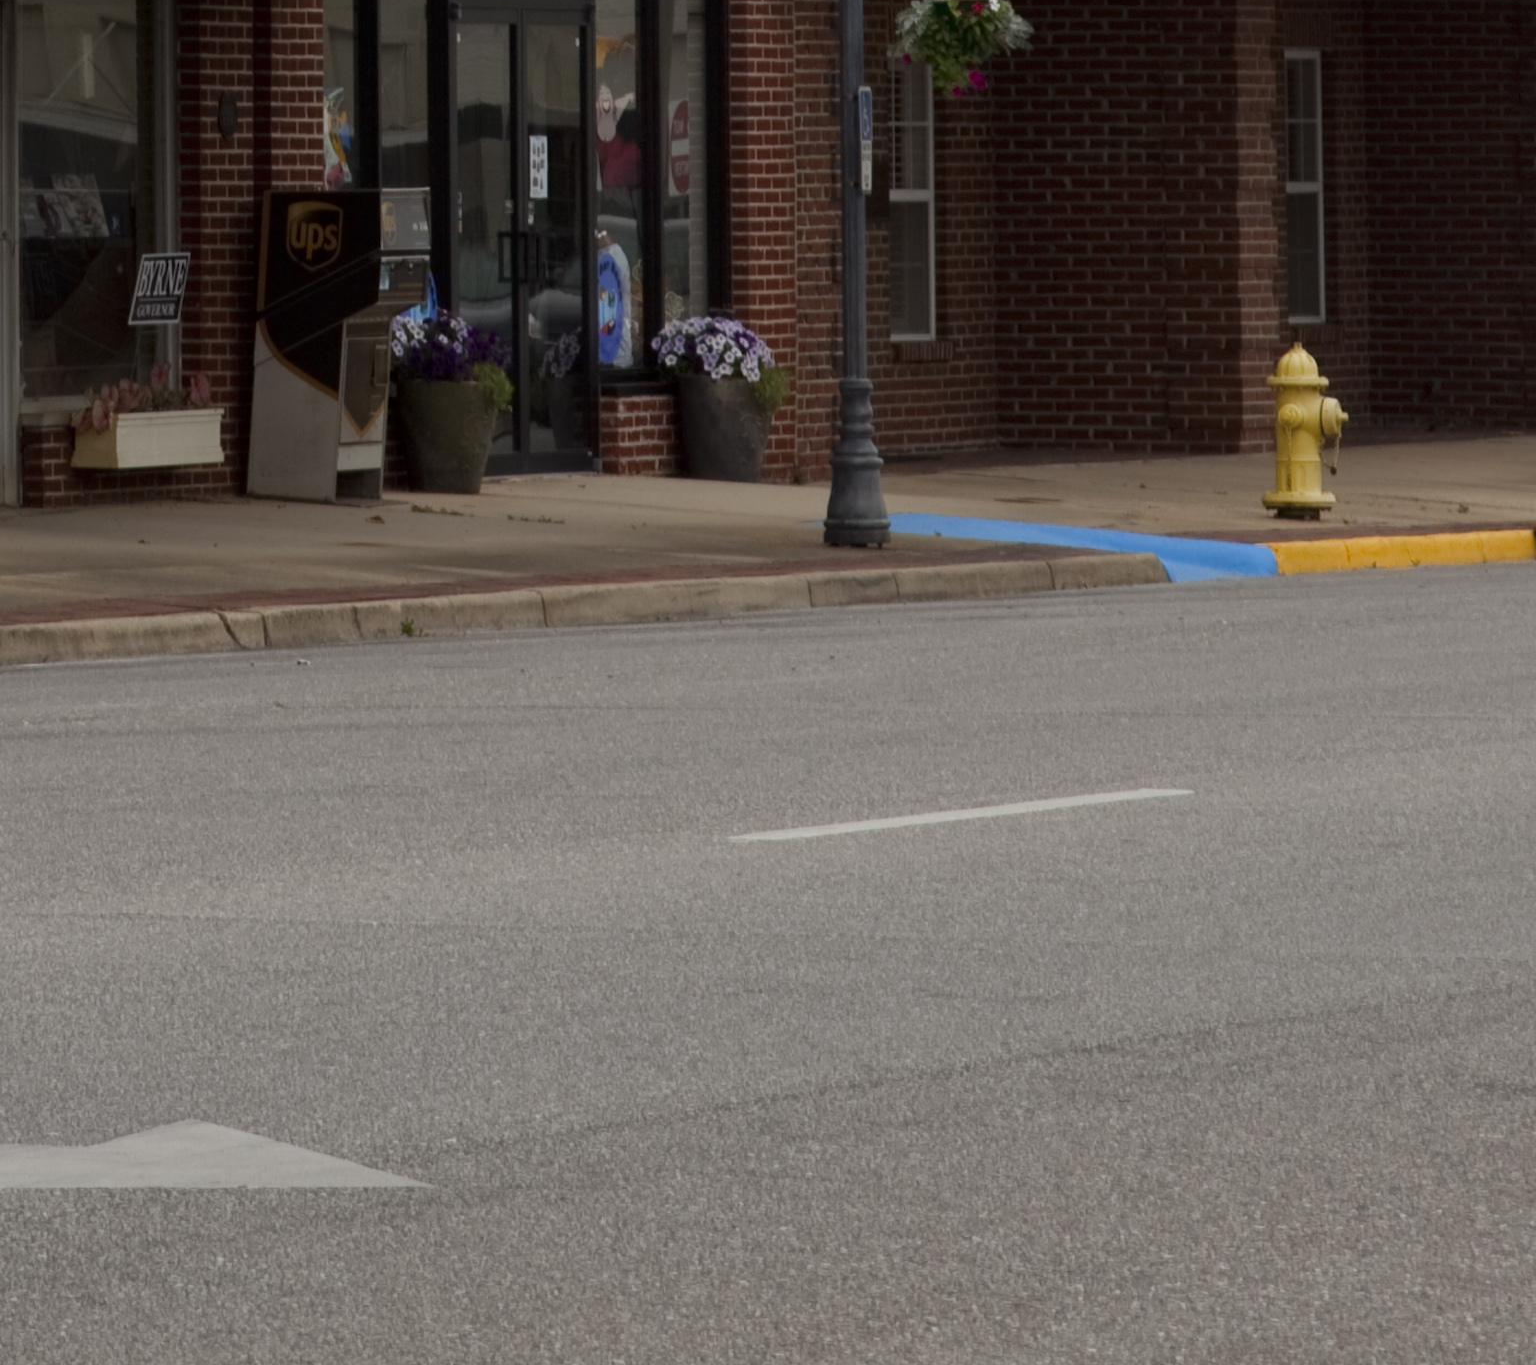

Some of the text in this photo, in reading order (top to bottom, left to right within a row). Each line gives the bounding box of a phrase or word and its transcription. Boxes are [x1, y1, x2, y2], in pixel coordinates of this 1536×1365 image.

[289, 222, 338, 261] ups
[136, 258, 187, 297] BYRNE
[136, 302, 176, 318] GOVERNOR
